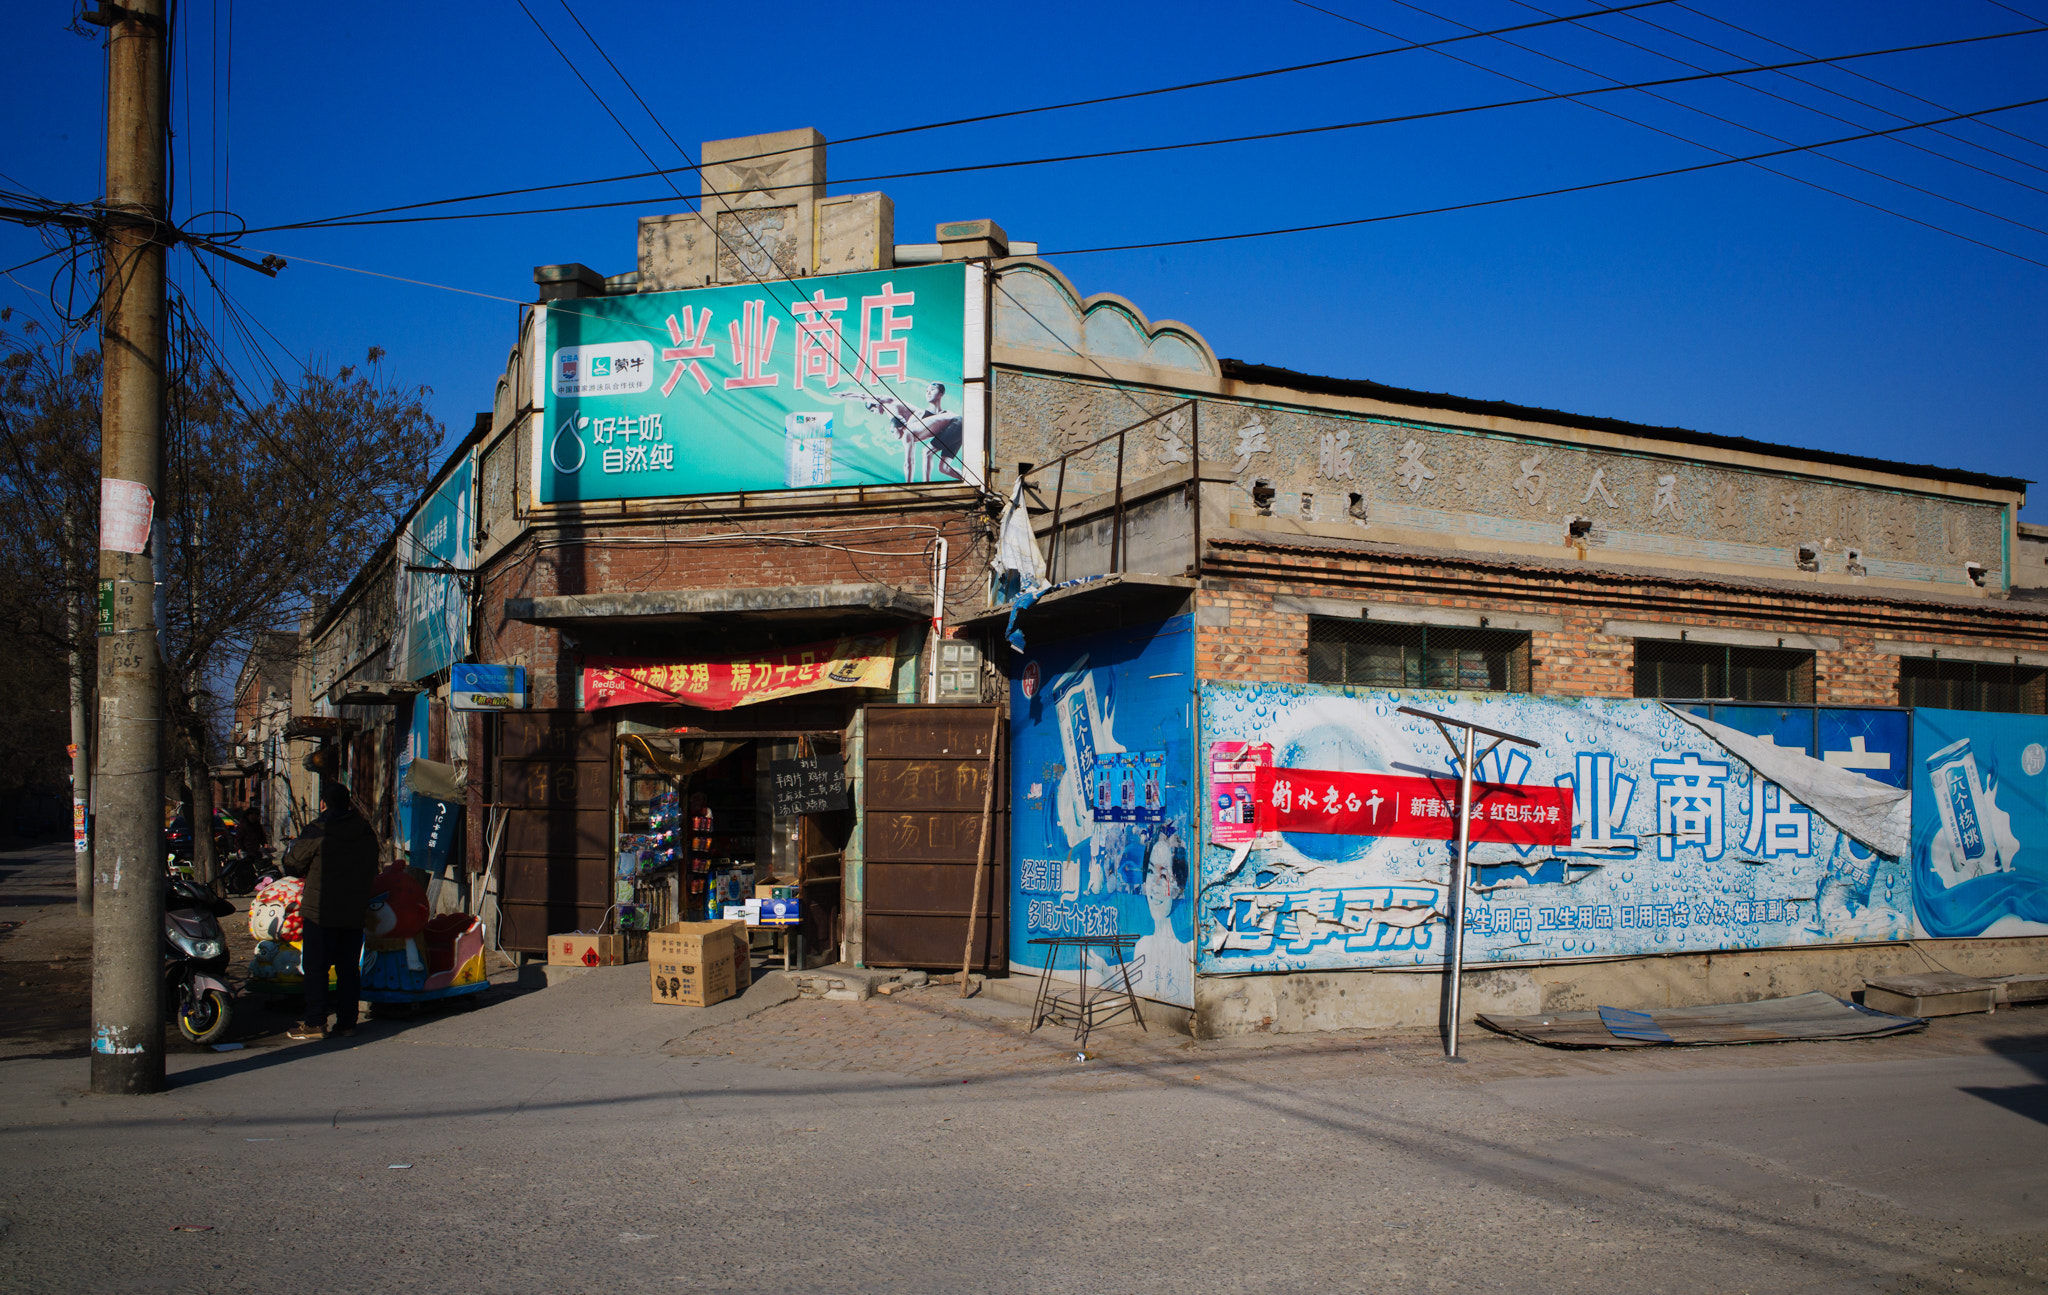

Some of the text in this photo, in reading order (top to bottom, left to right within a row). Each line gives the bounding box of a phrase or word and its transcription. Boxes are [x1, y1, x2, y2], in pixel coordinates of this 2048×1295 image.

[661, 281, 915, 398] 兴业商店
[561, 354, 579, 363] CSA
[614, 357, 645, 373] 蒙牛
[593, 413, 664, 445] 好牛奶
[603, 442, 674, 474] 自然纯
[593, 680, 626, 690] RedBull
[630, 661, 710, 693] 冲刺梦想
[730, 652, 816, 692] 精力十足
[598, 689, 617, 698] 红牛
[1271, 780, 1384, 825] 衡水老白干
[1490, 802, 1561, 825] 红包乐分享
[1950, 775, 1980, 849] 六个核桃
[1021, 859, 1070, 892] 经常用
[1028, 899, 1118, 937] 多喝六个核桃
[1537, 905, 1613, 931] 卫生用品
[1620, 902, 1690, 929] 日用百货
[1694, 901, 1730, 925] 冷饮
[1733, 898, 1800, 926] 烟酒副食
